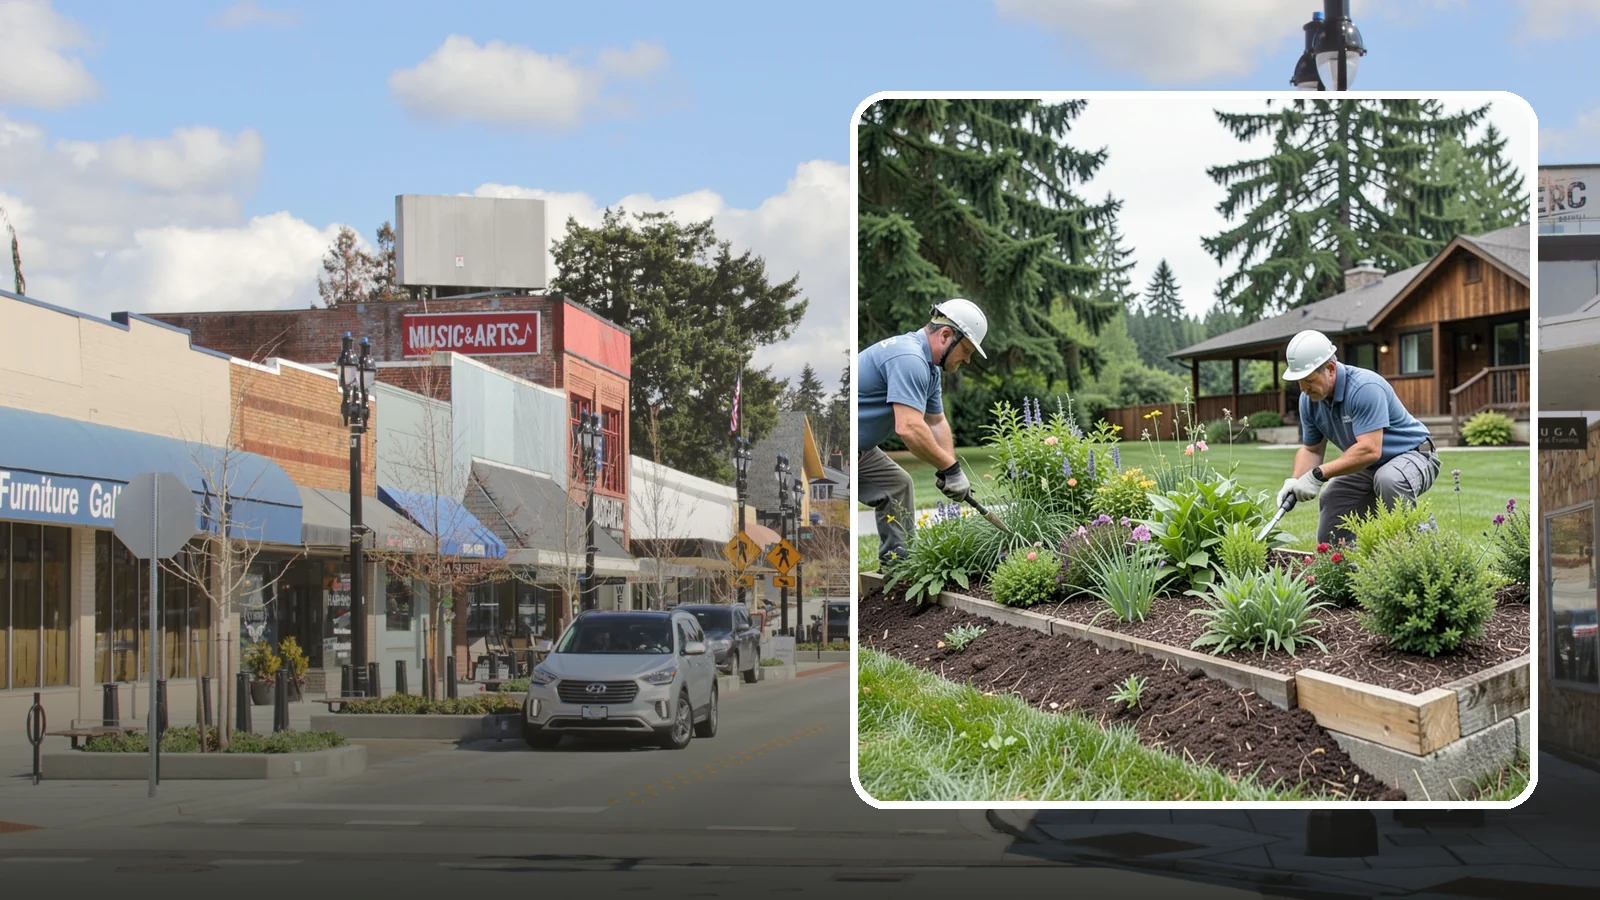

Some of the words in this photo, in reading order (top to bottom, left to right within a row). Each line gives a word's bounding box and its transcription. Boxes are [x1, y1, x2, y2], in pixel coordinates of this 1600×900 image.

[1540, 427, 1578, 437] UGA
[0, 471, 79, 516] Furniture
[89, 482, 122, 519] Gal
[453, 563, 479, 574] SUSHI
